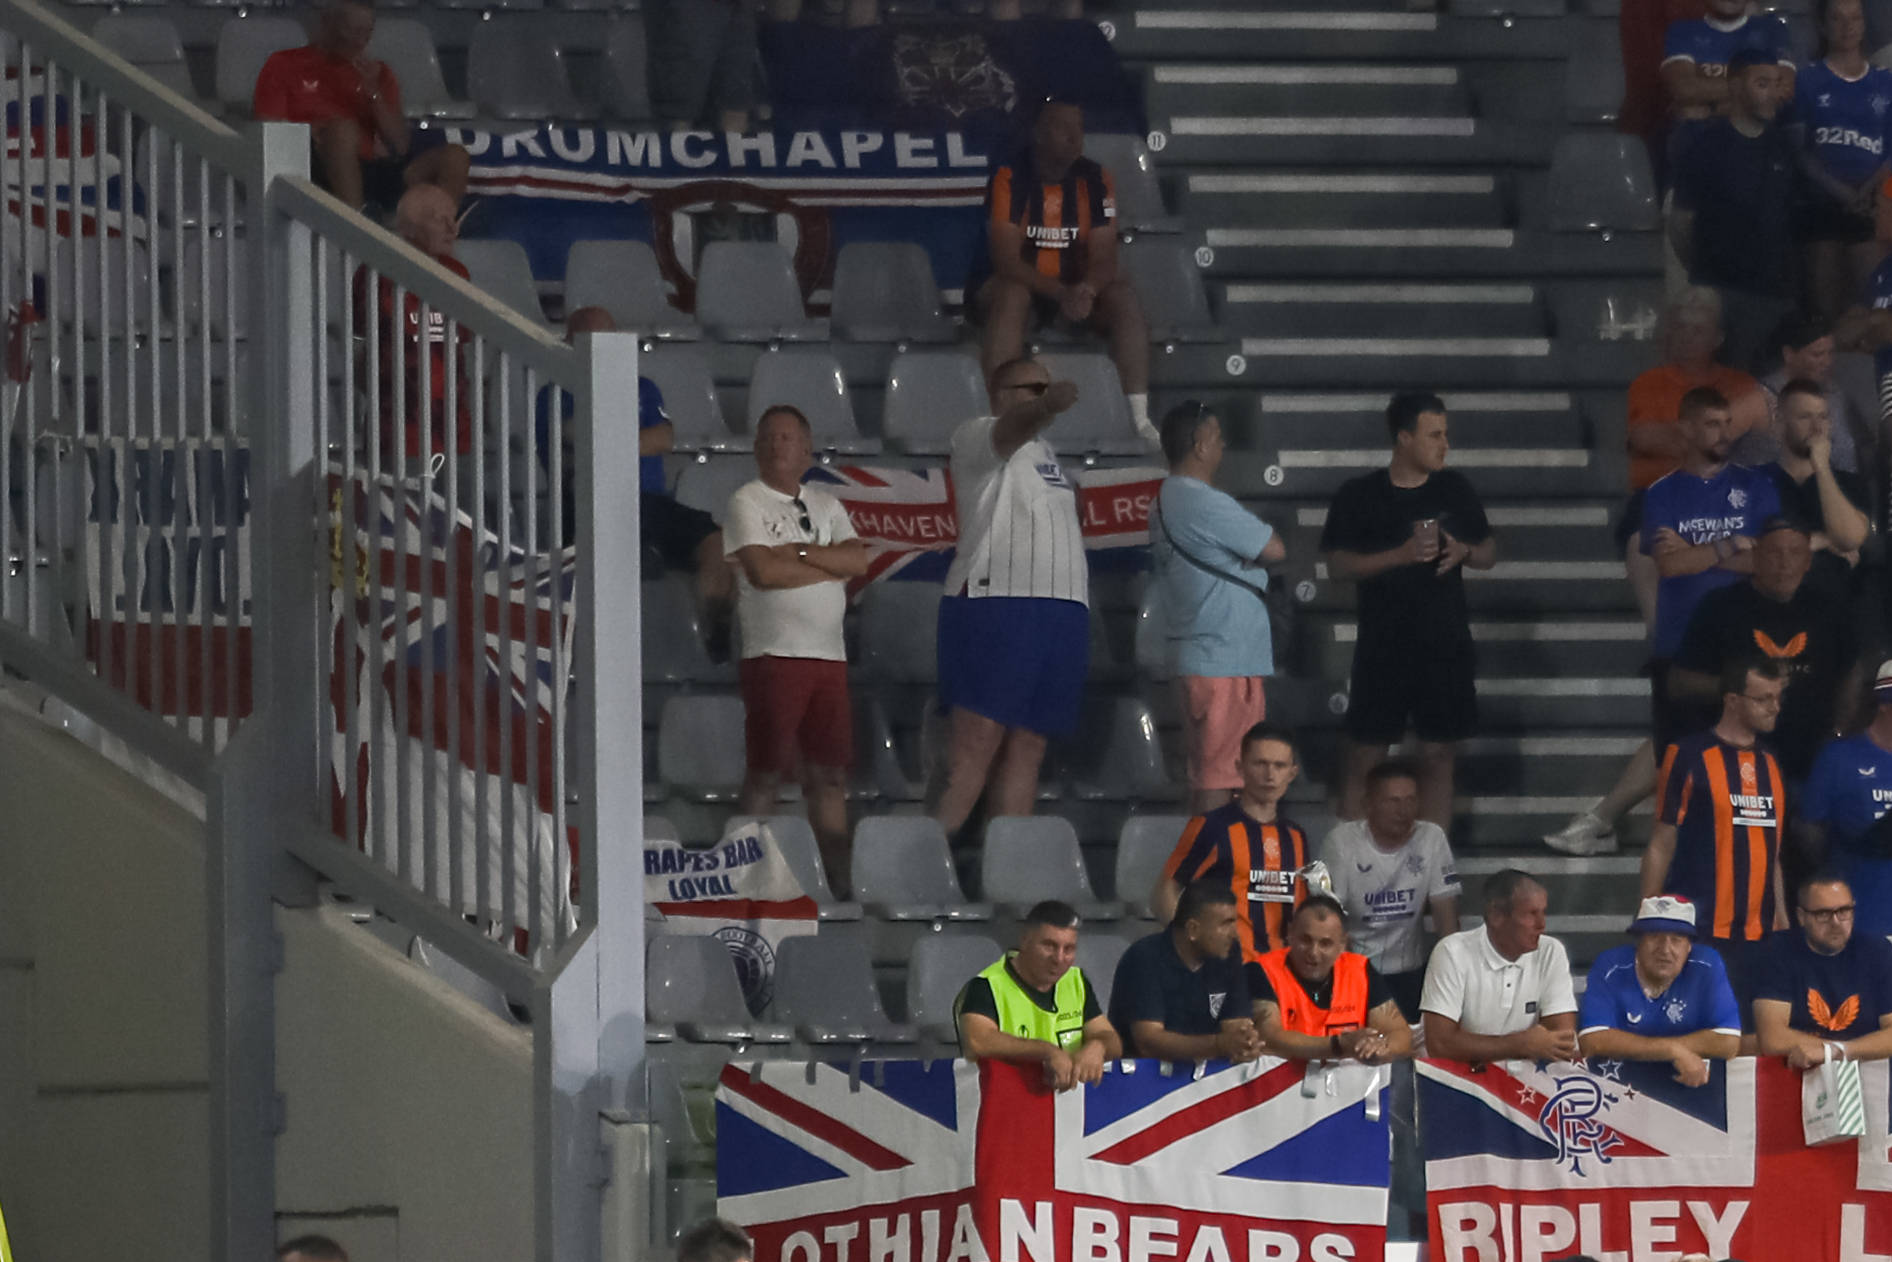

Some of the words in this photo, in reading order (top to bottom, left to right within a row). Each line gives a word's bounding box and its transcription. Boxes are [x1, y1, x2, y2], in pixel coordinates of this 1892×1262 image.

[446, 128, 989, 169] DRUMCHAPEL
[1816, 126, 1883, 155] 32Red
[1026, 225, 1080, 240] UNIBET
[1729, 794, 1774, 810] UNIBET
[1249, 869, 1297, 885] UNIBET
[668, 874, 737, 901] LOYAL
[1365, 888, 1416, 905] UNIBET
